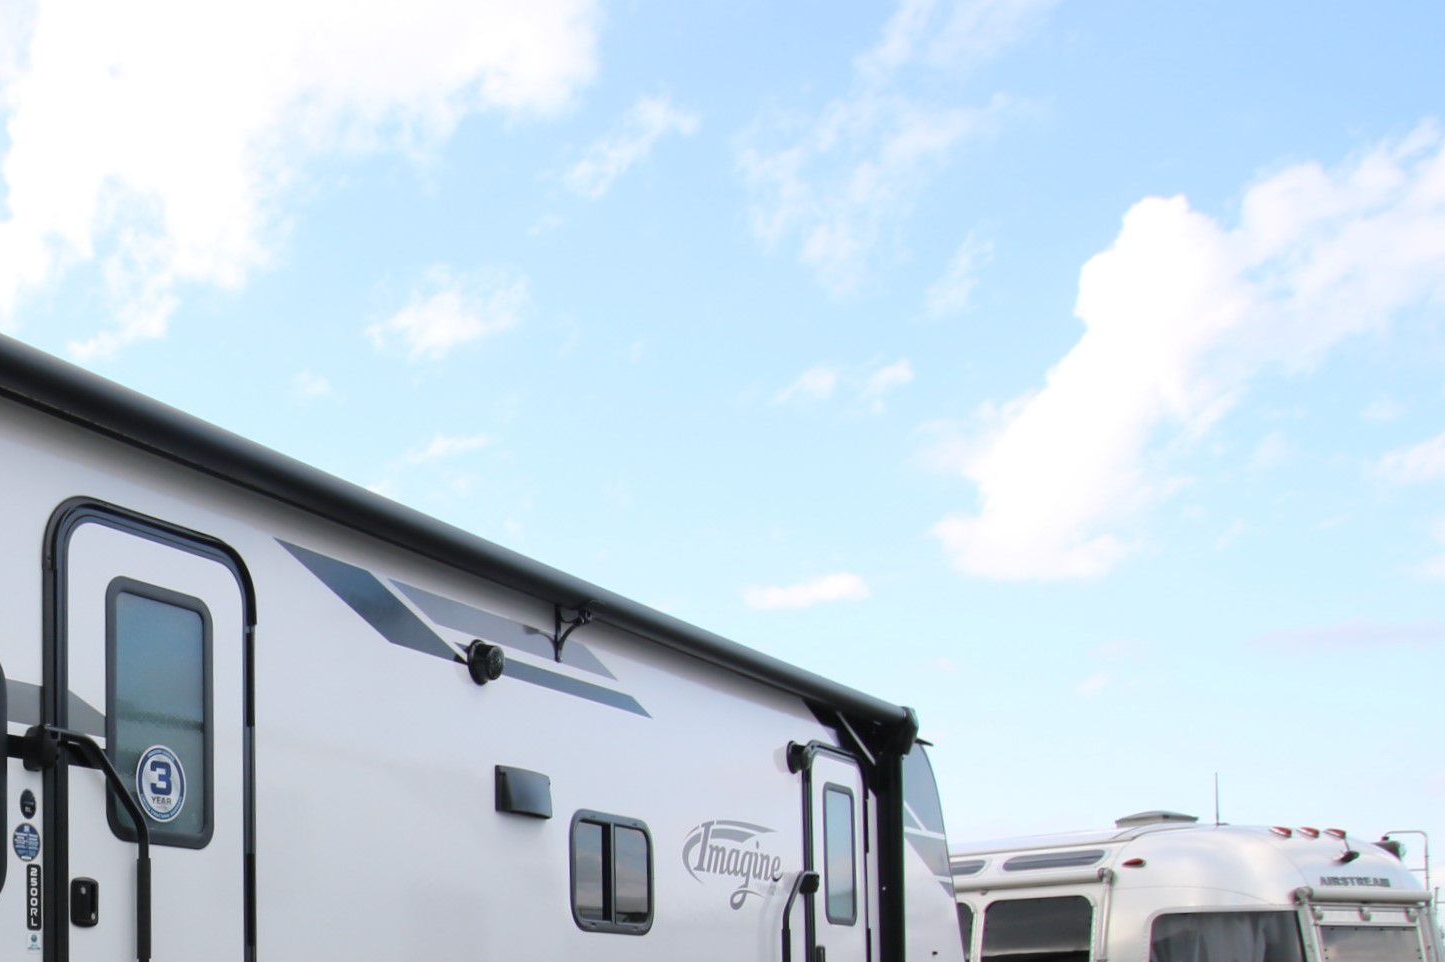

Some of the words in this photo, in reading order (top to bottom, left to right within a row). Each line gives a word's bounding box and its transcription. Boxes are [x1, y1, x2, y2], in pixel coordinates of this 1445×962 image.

[150, 760, 172, 796] 3
[151, 796, 172, 805] YEAR
[693, 819, 784, 910] Imagine
[1320, 876, 1391, 888] AIRSTREAM
[30, 866, 38, 926] 2500RL
